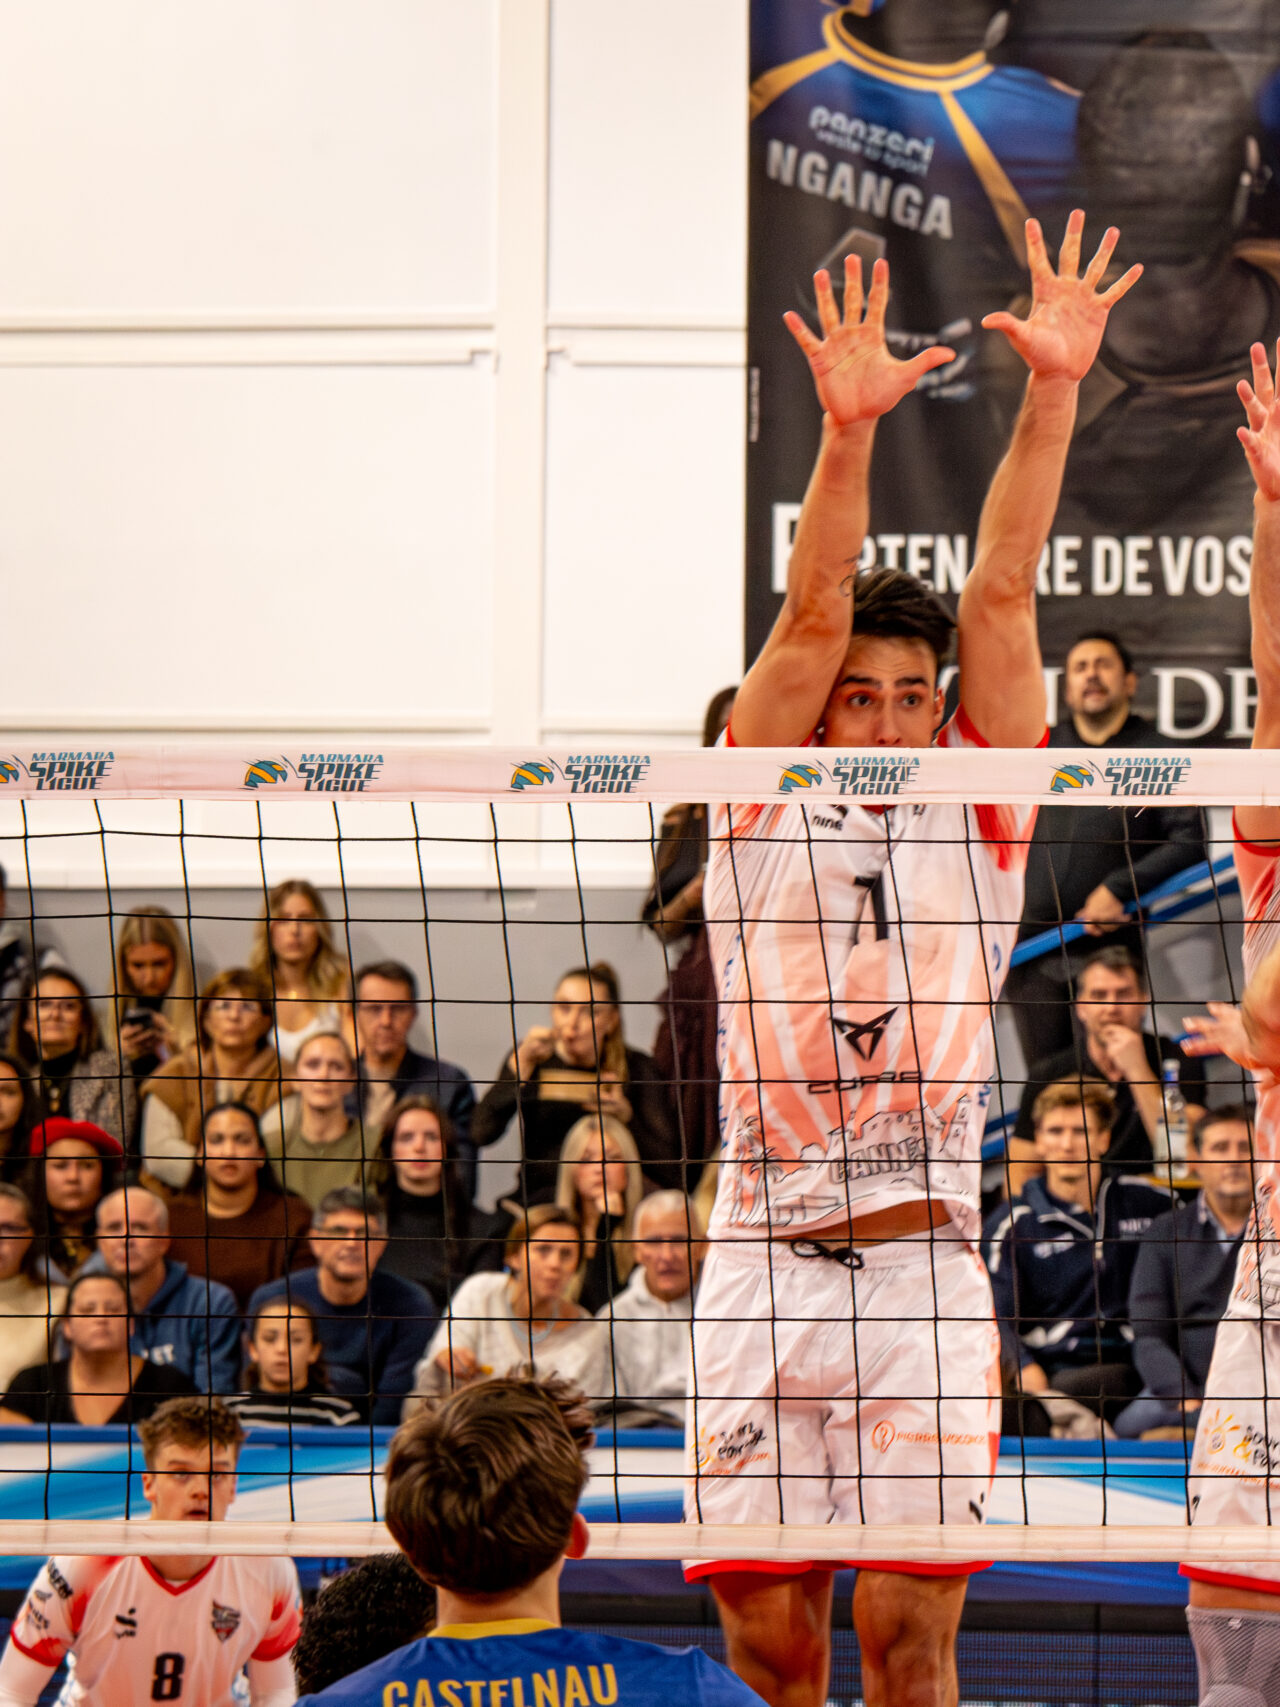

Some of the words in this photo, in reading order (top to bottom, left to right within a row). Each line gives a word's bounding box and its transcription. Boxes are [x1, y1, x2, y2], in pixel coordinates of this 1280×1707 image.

[766, 138, 954, 241] NGANGA
[1091, 534, 1154, 597] DE
[1158, 534, 1253, 598] VOS
[32, 751, 115, 762] MARMARA
[300, 753, 384, 764] MARMARA
[567, 754, 651, 765] MARMARA
[835, 756, 920, 767] MARMARA
[1107, 757, 1192, 767] MARMARA
[29, 761, 114, 782] SPIKE
[298, 763, 384, 783] SPIKE
[565, 765, 651, 784] SPIKE
[833, 766, 920, 786] SPIKE
[1105, 766, 1192, 786] SPIKE
[36, 777, 104, 790] LIGUE
[304, 779, 372, 792] LIGUE
[570, 780, 639, 793] LIGUE
[839, 782, 909, 795] LIGUE
[1111, 782, 1180, 796] LIGUE
[151, 1652, 186, 1703] 8
[382, 1663, 619, 1707] CASTELNAU
